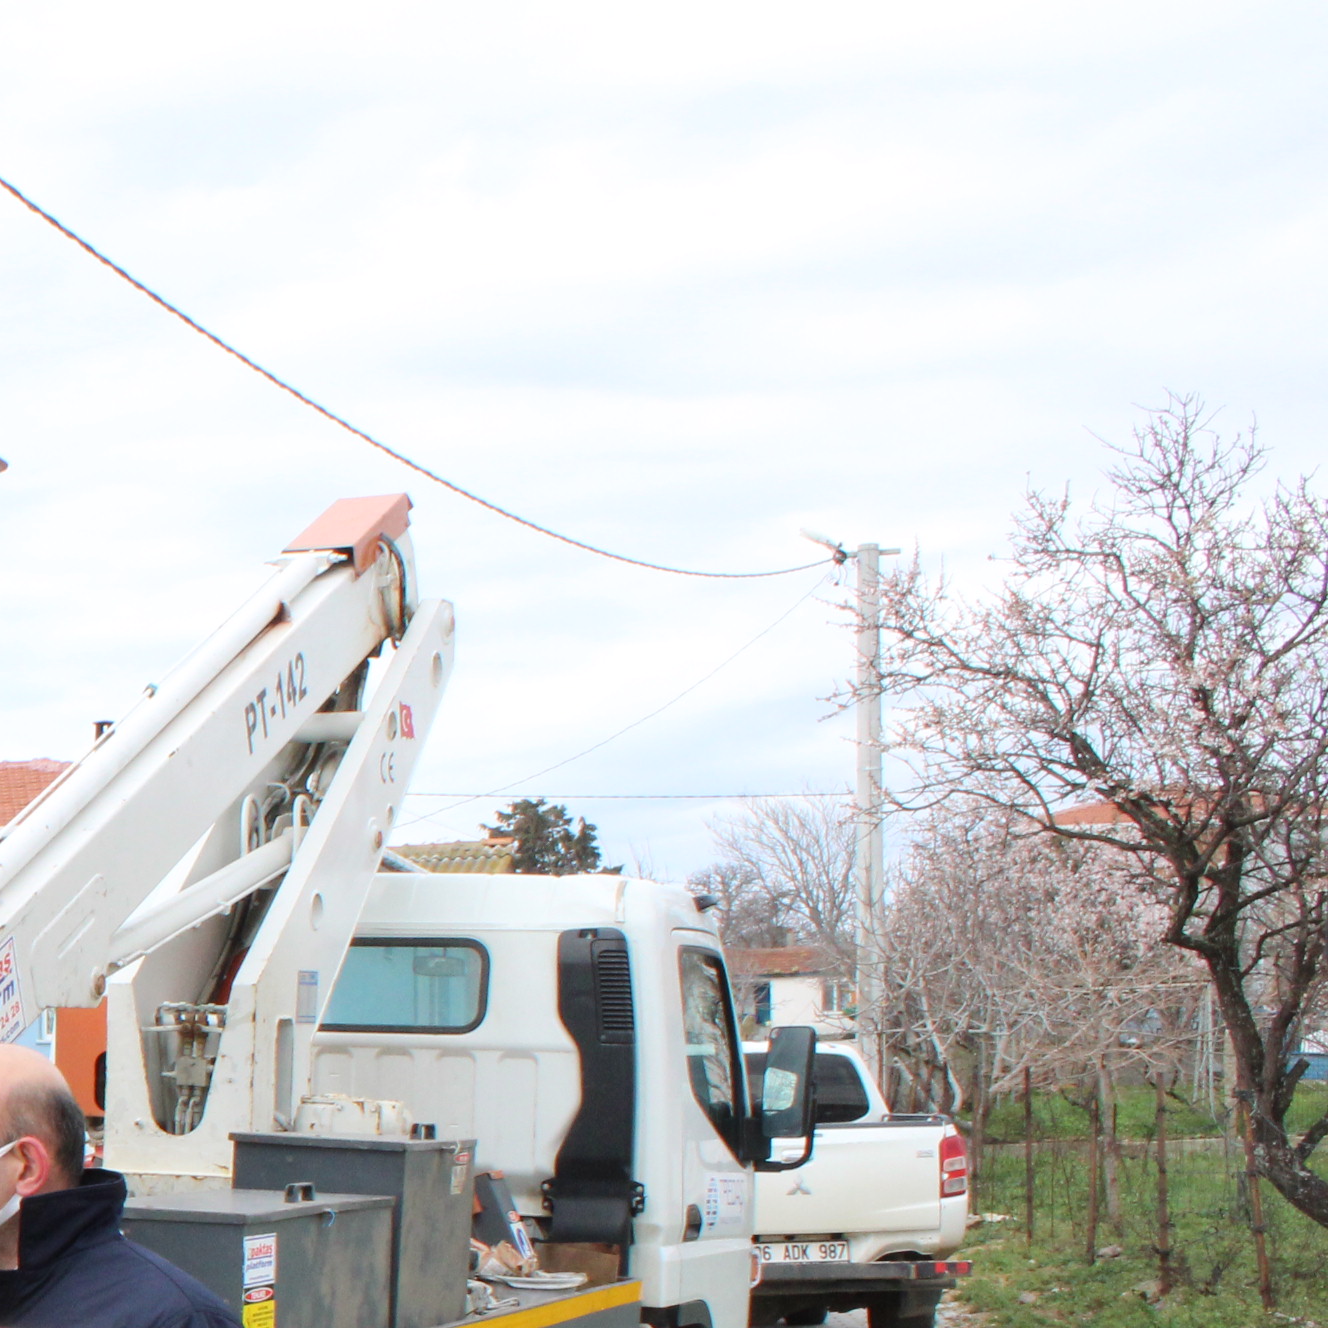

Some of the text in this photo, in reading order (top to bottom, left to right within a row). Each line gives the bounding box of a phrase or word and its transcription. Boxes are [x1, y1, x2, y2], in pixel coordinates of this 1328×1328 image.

[245, 652, 307, 755] PT-142
[783, 1244, 810, 1260] ADK
[818, 1243, 846, 1259] 987
